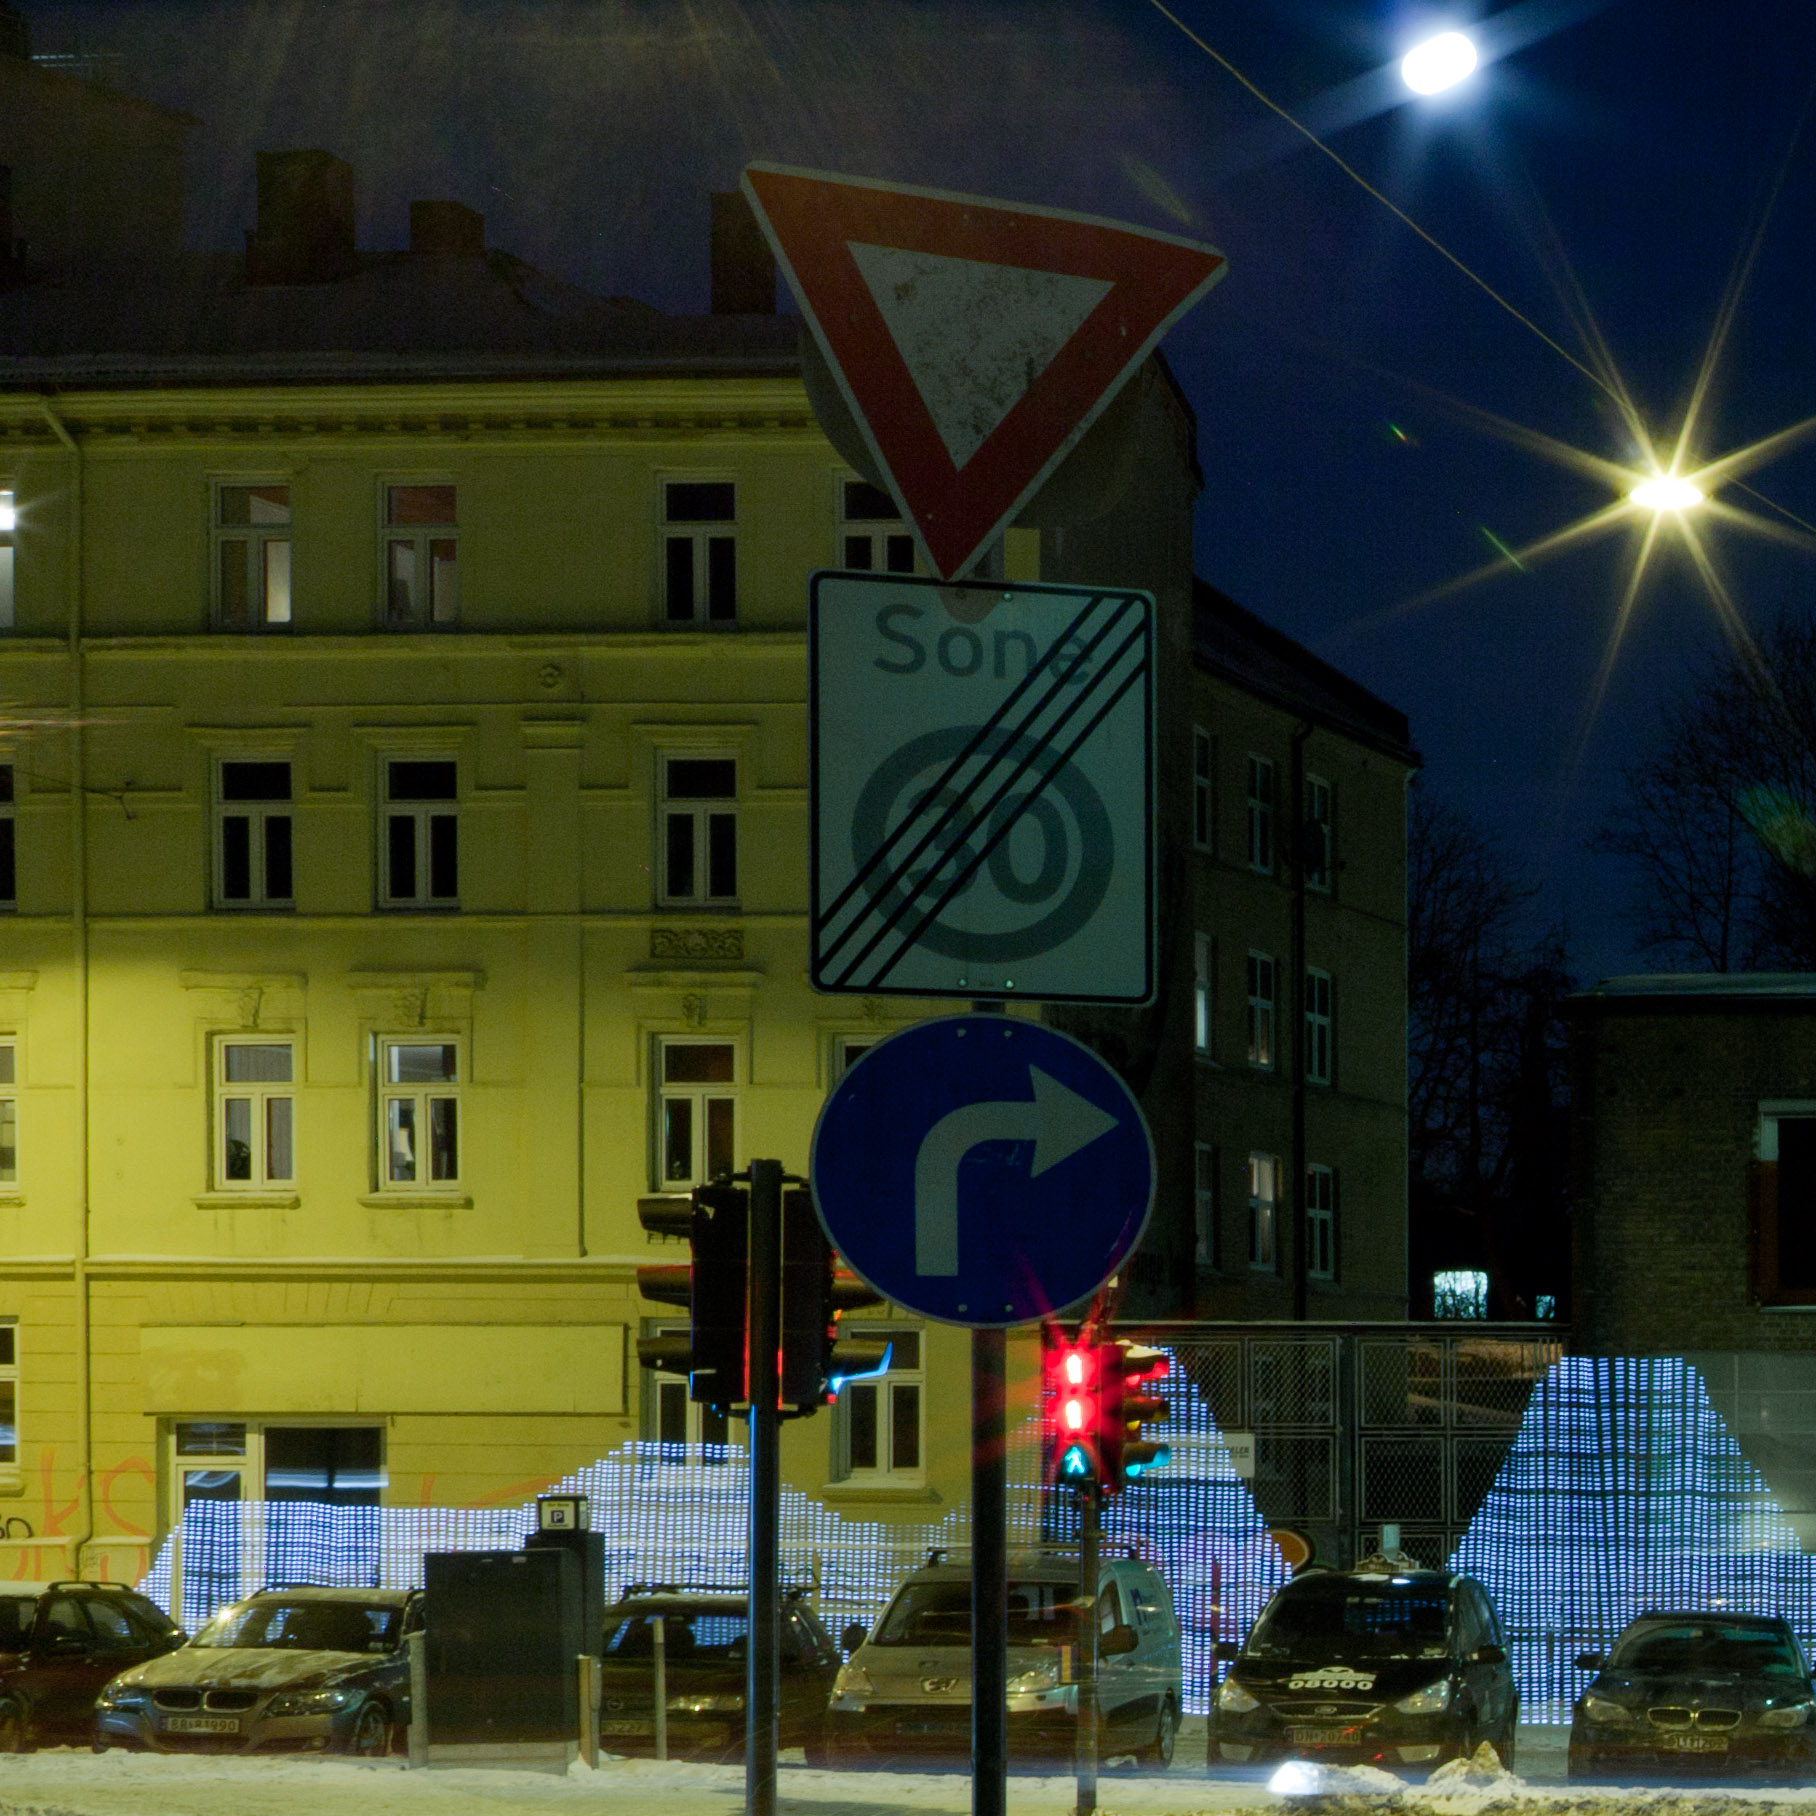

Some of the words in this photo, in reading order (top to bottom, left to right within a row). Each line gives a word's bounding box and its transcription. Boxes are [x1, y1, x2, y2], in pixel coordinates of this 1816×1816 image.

[872, 603, 1093, 686] Sone
[906, 787, 1069, 905] 30
[1288, 1679, 1373, 1690] 08000
